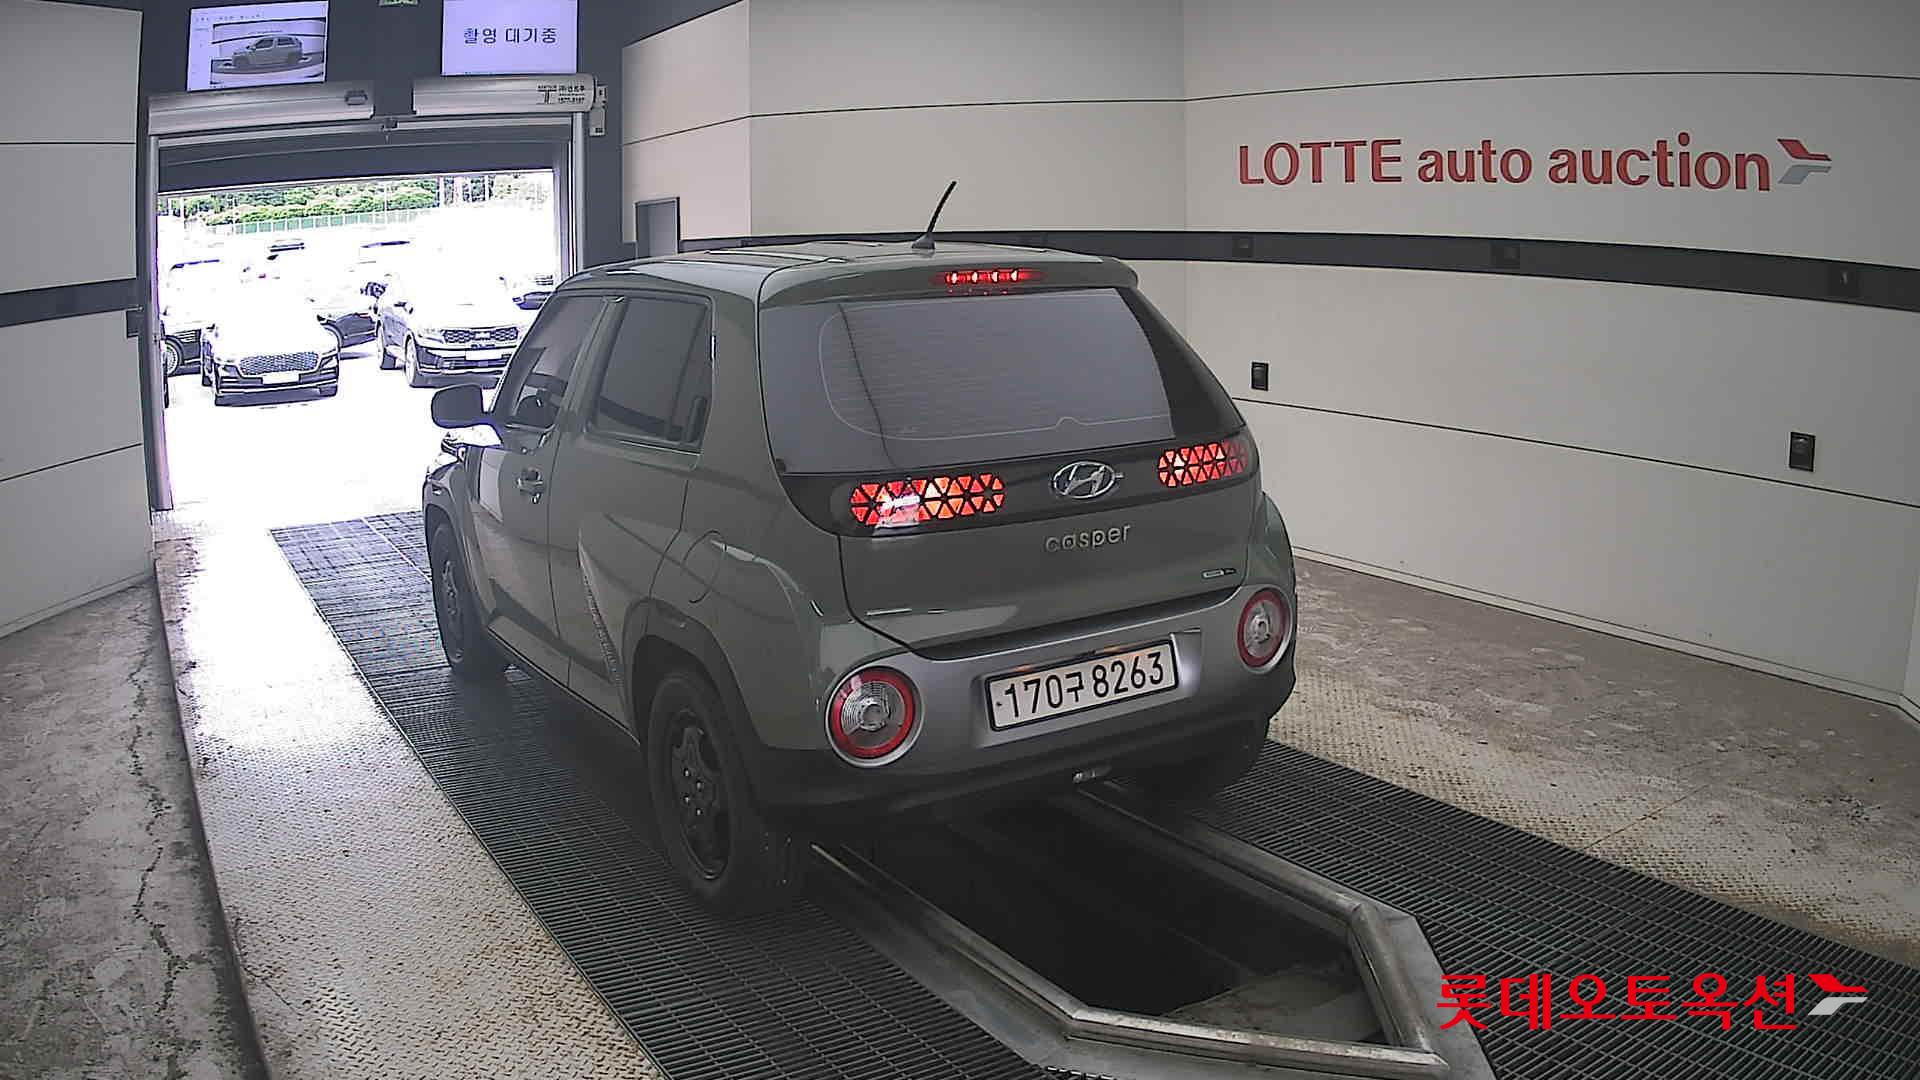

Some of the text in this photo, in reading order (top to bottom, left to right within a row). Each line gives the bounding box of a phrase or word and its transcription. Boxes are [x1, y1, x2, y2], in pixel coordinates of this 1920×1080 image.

[464, 27, 557, 44] 촬영 대기중
[1239, 132, 1771, 192] LOTTE auto auction
[1045, 523, 1132, 553] casper
[1092, 651, 1164, 698] 8263
